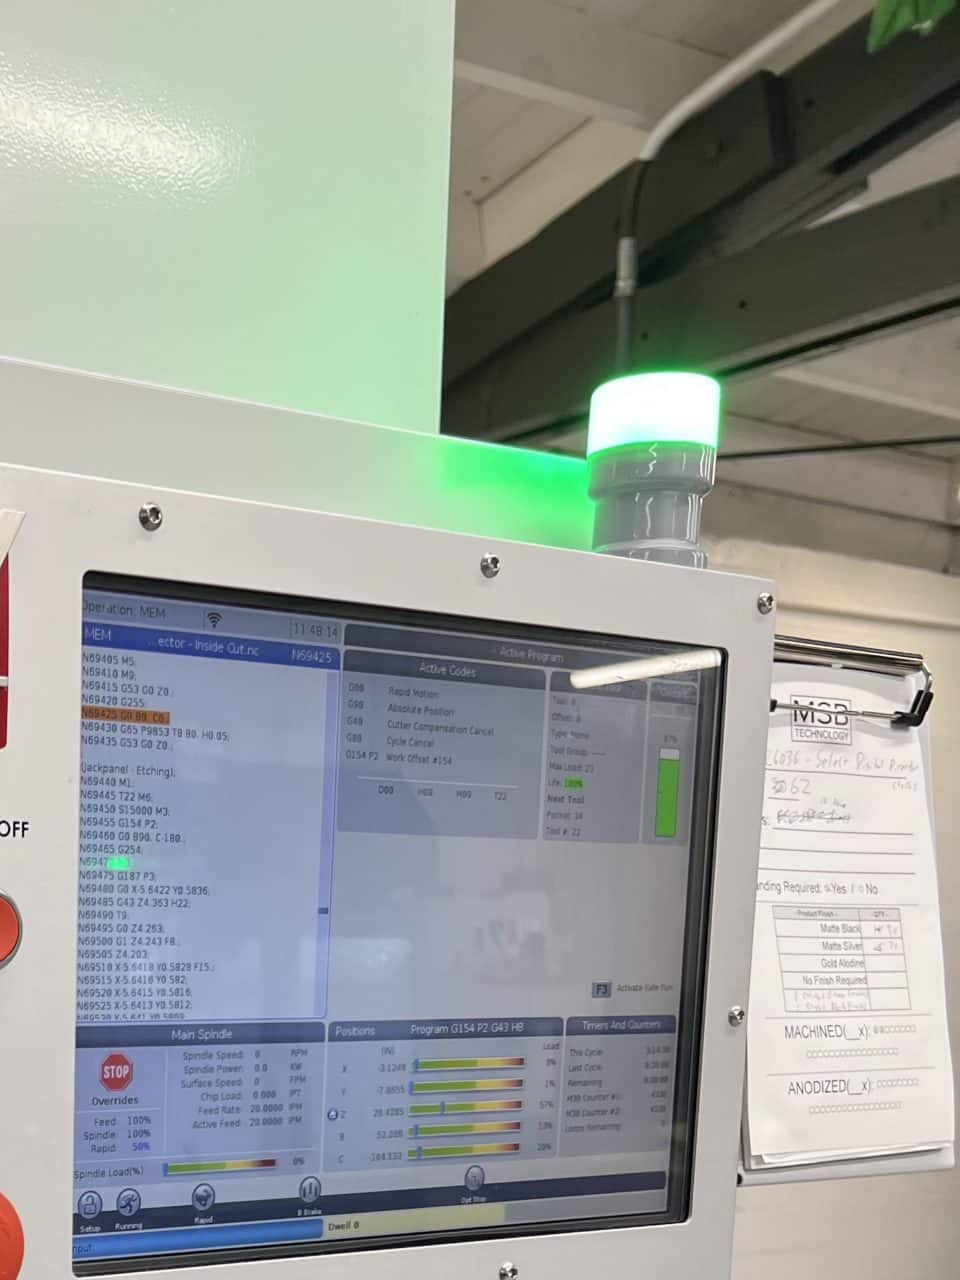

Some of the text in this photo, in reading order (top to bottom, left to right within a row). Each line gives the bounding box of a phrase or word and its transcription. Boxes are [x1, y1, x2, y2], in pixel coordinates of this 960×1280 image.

[140, 606, 165, 619] MEM
[85, 629, 111, 641] MEM
[194, 640, 223, 652] Inside
[419, 662, 477, 678] Active Codes
[793, 700, 849, 725] MSB
[796, 728, 849, 741] TECHNOLOGY
[832, 882, 846, 894] Yes
[866, 883, 878, 895] No
[820, 924, 840, 934] Matte
[842, 924, 862, 934] Black
[822, 941, 841, 951] Matte
[843, 941, 863, 952] Silver
[821, 958, 836, 968] Gold
[803, 976, 868, 987] No Finish Required
[172, 1029, 232, 1041] Main Spindle
[336, 1025, 376, 1038] Positions
[411, 1023, 449, 1036] Program
[452, 1023, 475, 1034] G154
[478, 1023, 489, 1033] P2
[491, 1022, 510, 1033] G43
[104, 1065, 129, 1079] STOP
[92, 1096, 139, 1106] Overrides
[94, 1115, 151, 1126] Feed 100%
[83, 1129, 151, 1141] Spindle 100%
[91, 1142, 150, 1154] Rapid 50%
[328, 1221, 351, 1232] Dwell
